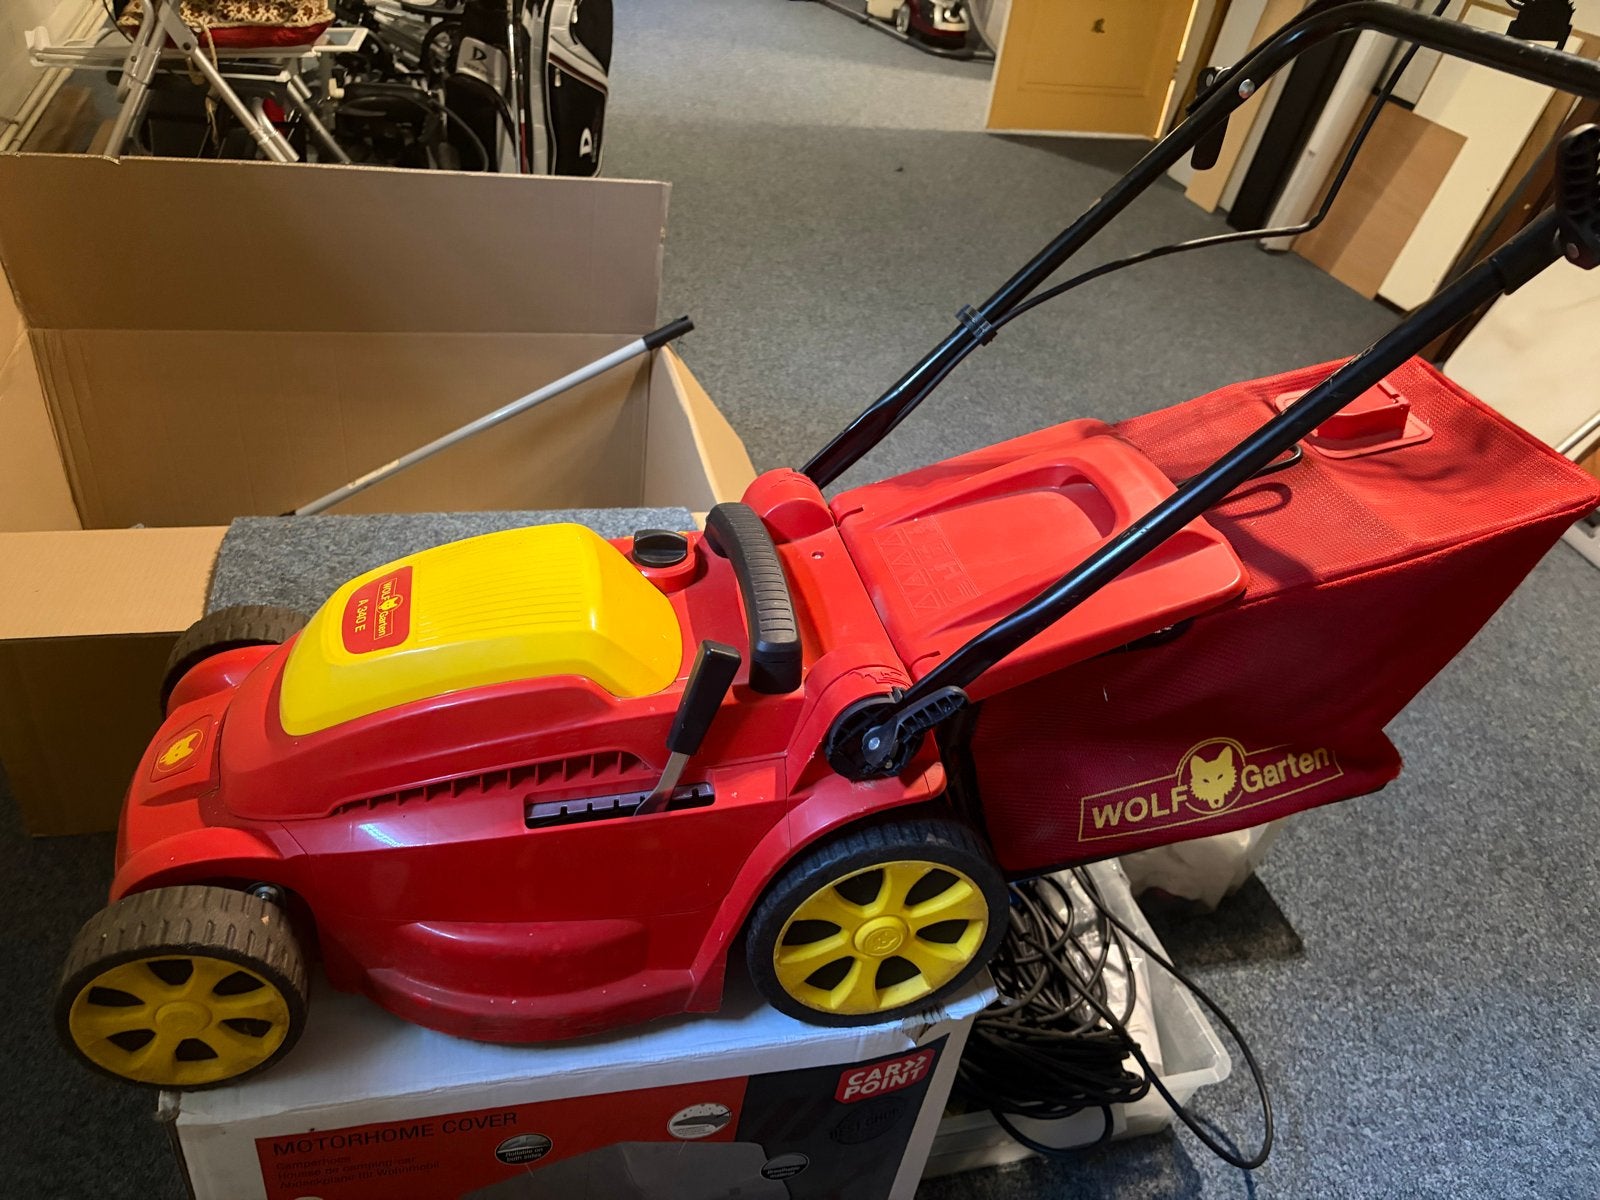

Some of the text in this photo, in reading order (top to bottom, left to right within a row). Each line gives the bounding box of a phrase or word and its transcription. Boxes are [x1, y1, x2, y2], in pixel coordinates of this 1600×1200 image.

[356, 606, 367, 624] 340
[378, 581, 393, 636] WOLF Garten
[355, 624, 366, 633] E
[1091, 747, 1330, 829] WOLF Garten
[843, 1066, 924, 1100] POINT
[848, 1063, 901, 1086] CAR
[272, 1112, 517, 1157] MOTORHOME COVER
